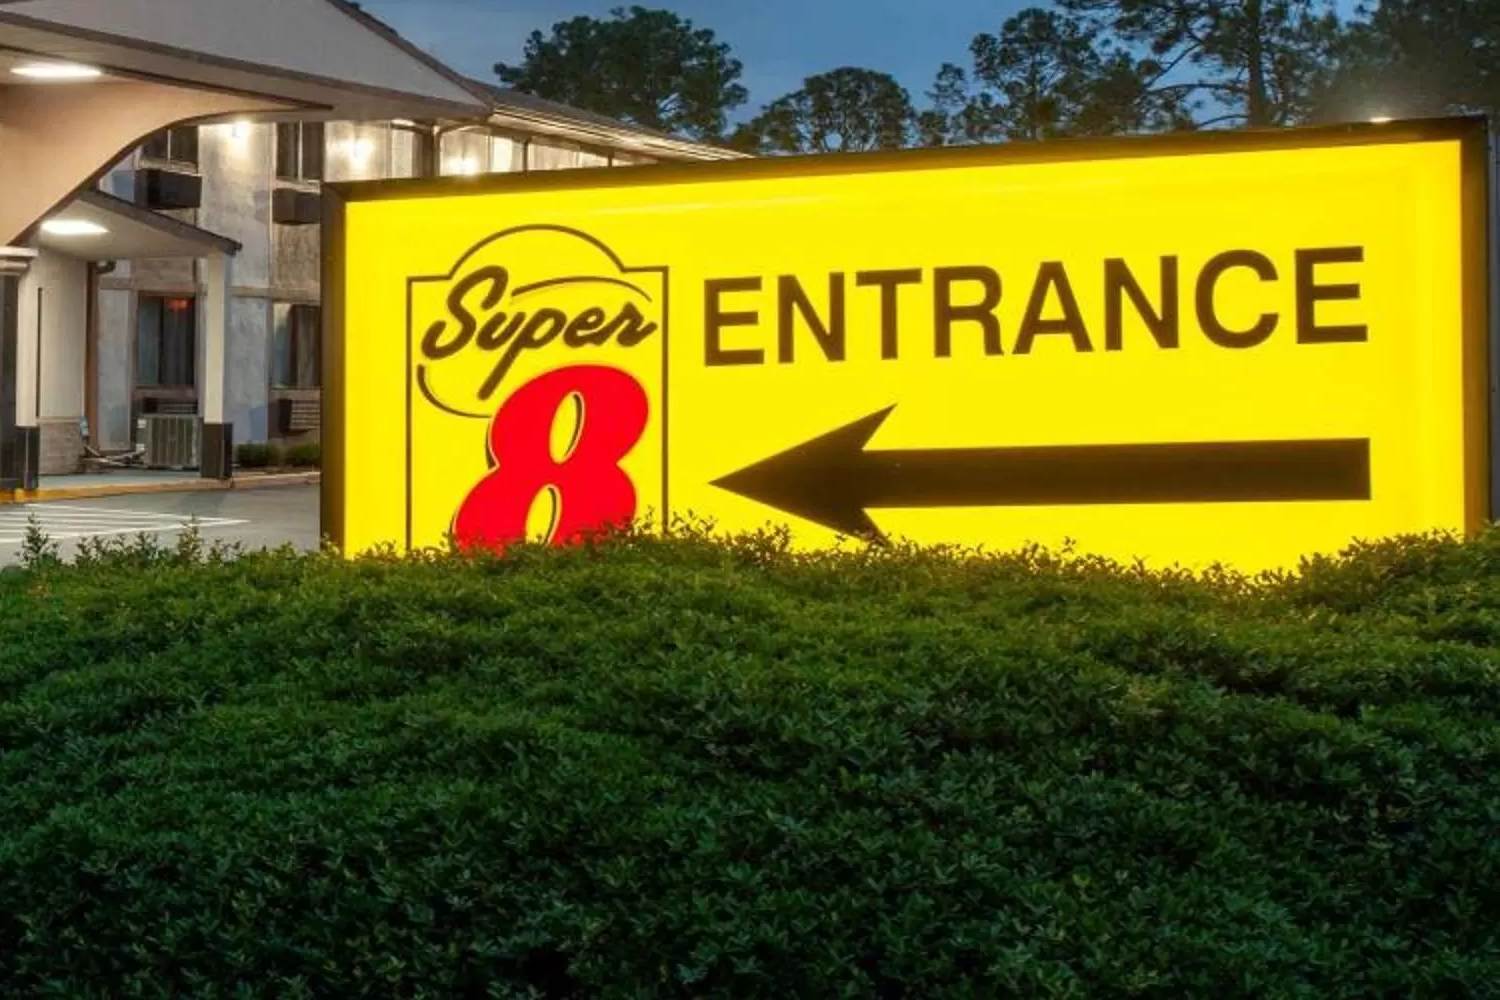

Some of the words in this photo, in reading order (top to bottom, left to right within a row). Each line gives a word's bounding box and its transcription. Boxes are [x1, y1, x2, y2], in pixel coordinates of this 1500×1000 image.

[420, 264, 658, 401] Super
[703, 245, 1369, 368] ENTRANCE
[451, 362, 650, 557] 8
